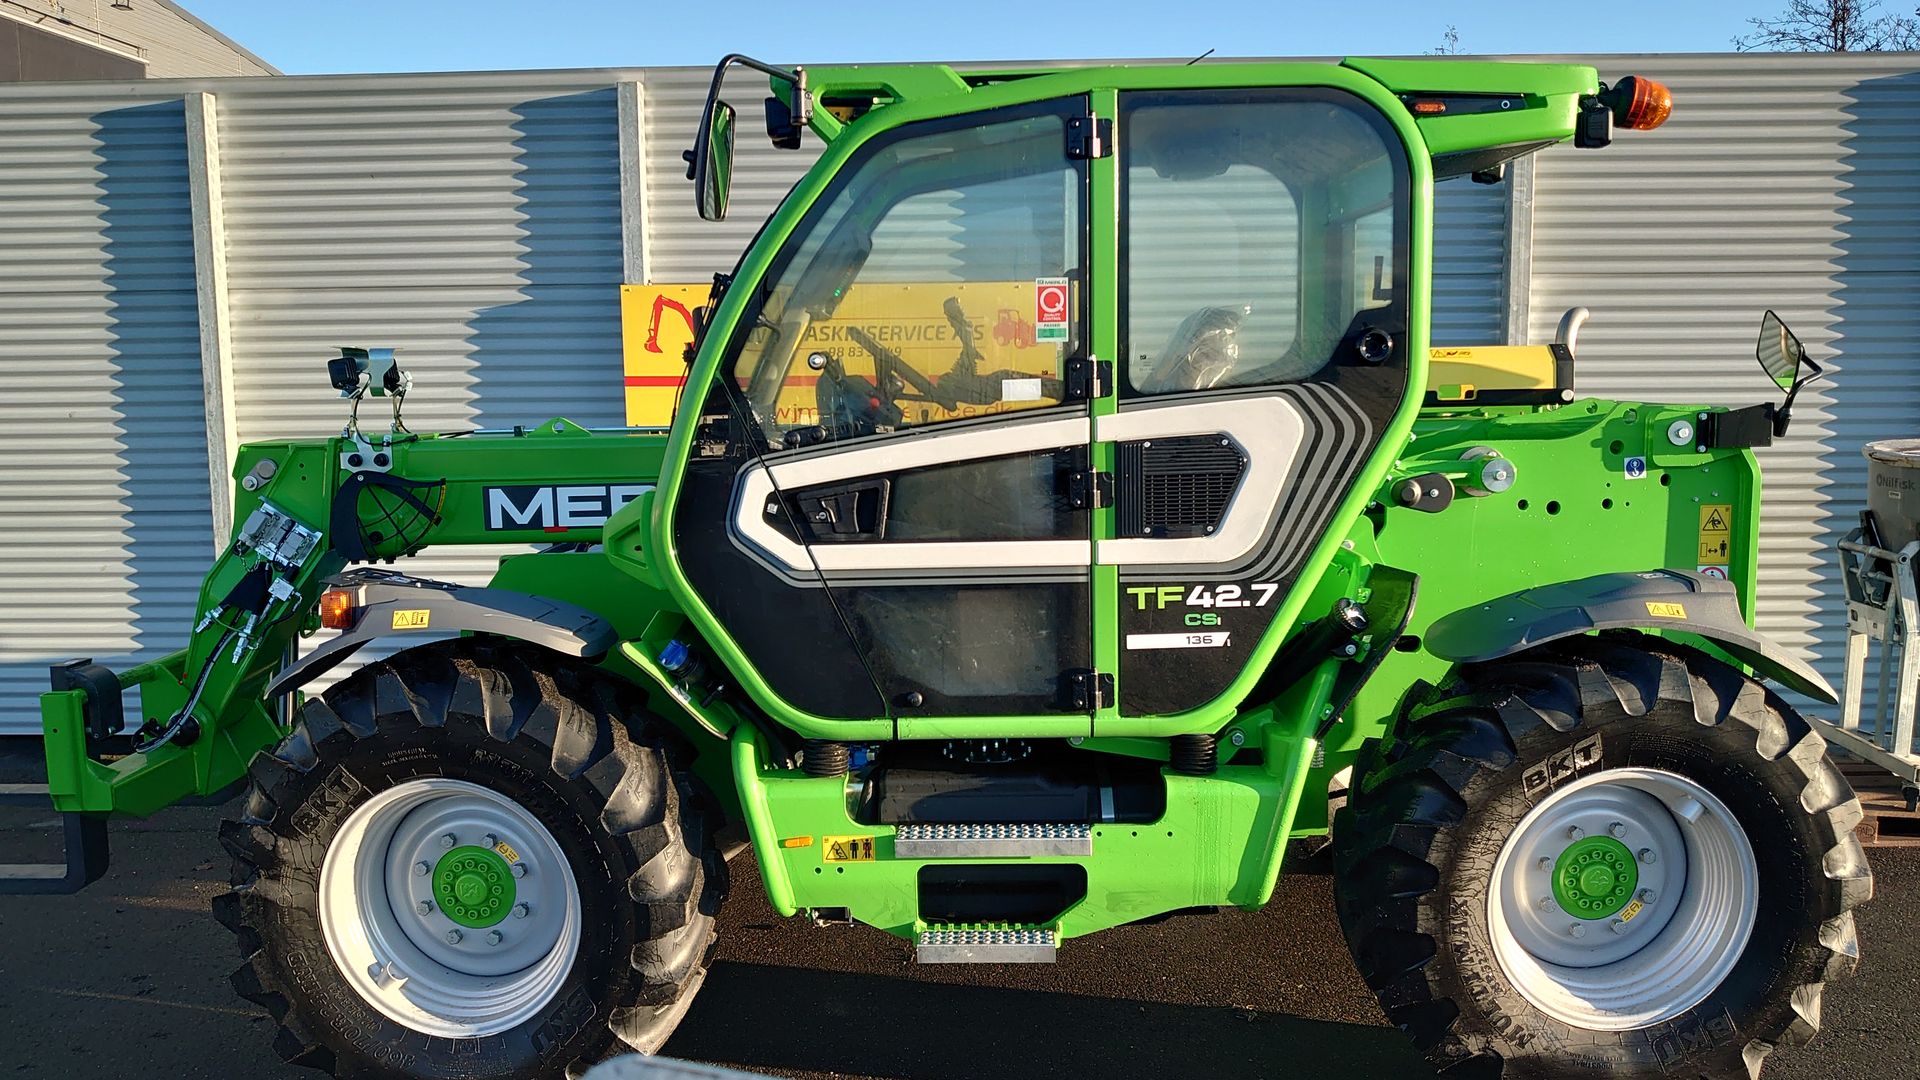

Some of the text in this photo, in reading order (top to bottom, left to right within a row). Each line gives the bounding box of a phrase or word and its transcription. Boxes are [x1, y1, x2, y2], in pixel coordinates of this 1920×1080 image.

[1040, 287, 1064, 312] Q
[847, 346, 863, 357] 83
[1127, 583, 1279, 610] TF42.7
[1186, 635, 1213, 645] 136
[1523, 736, 1601, 796] BKT
[292, 766, 359, 838] BKT
